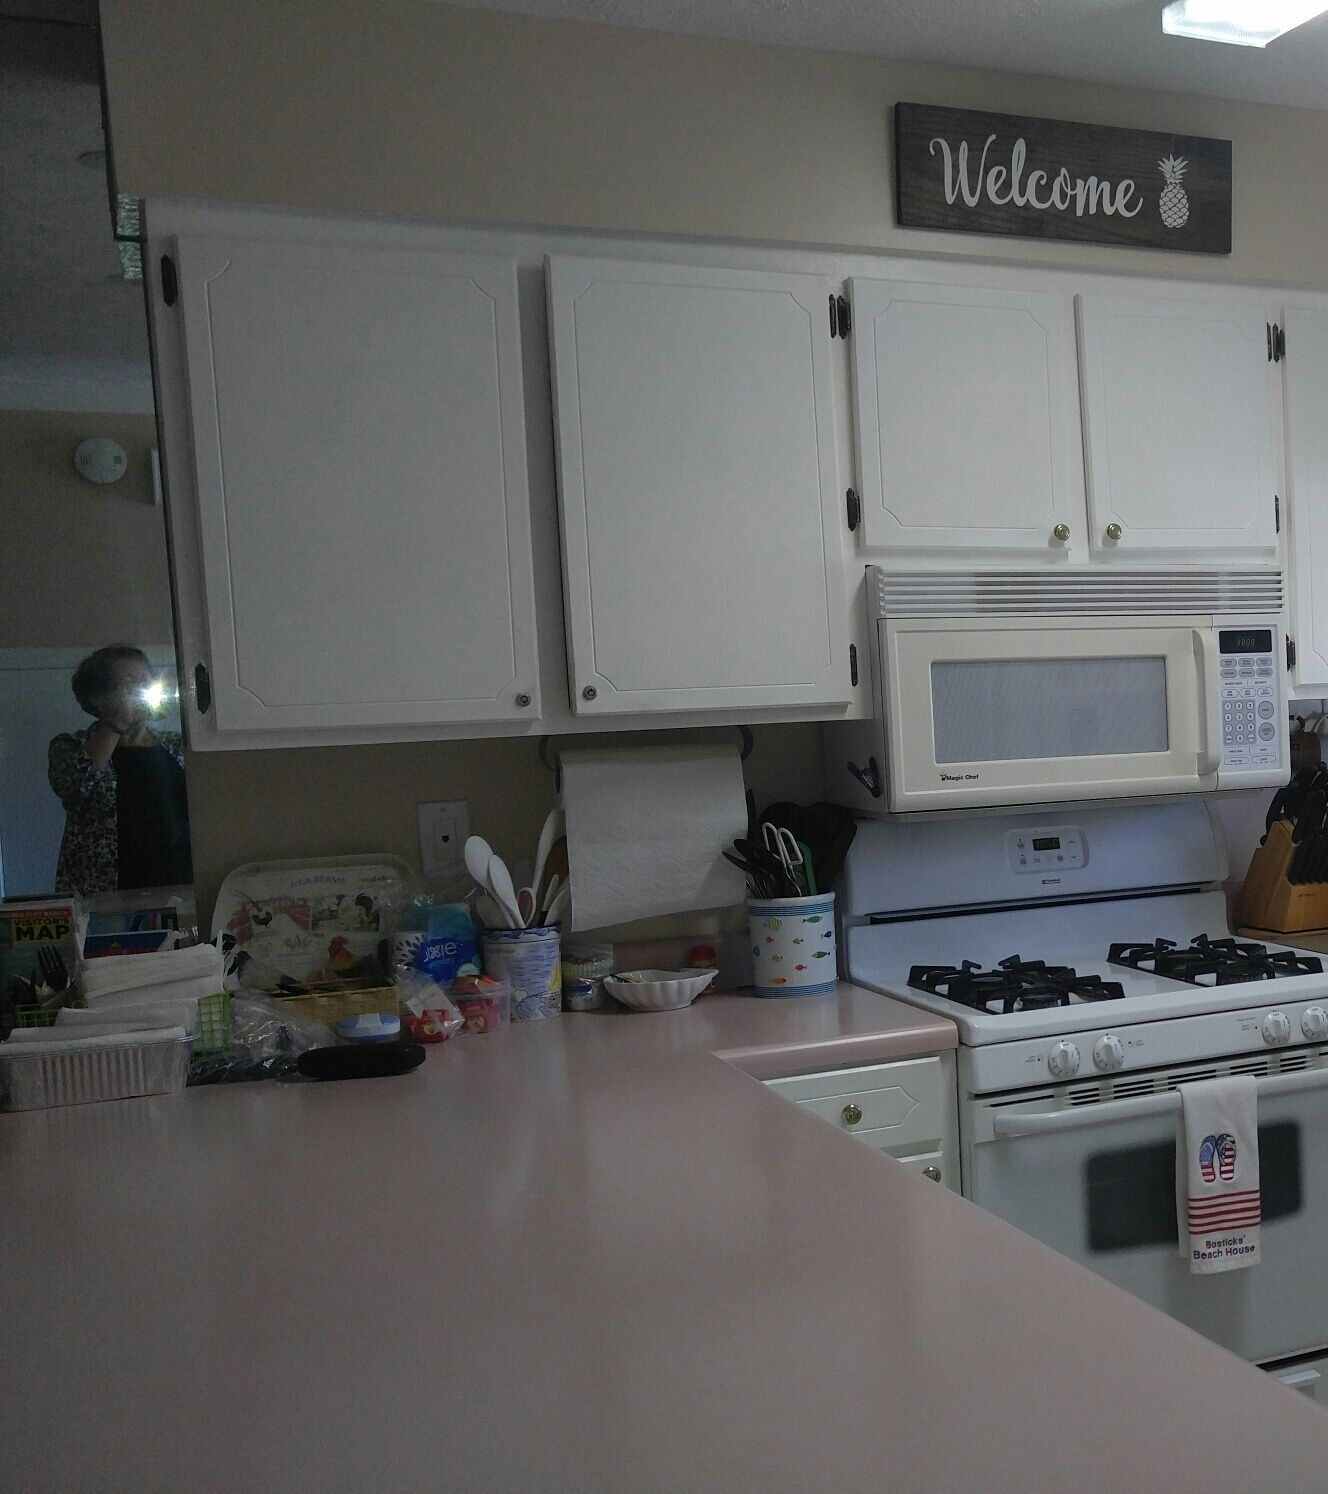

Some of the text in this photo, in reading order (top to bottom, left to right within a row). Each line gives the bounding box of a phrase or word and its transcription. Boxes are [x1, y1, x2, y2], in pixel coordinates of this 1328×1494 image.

[929, 134, 1143, 217] Welcome
[13, 917, 70, 926] VISITOR'S
[15, 925, 70, 941] MAP
[1205, 1234, 1246, 1249] Bosticks'
[1194, 1245, 1255, 1259] Beach House
